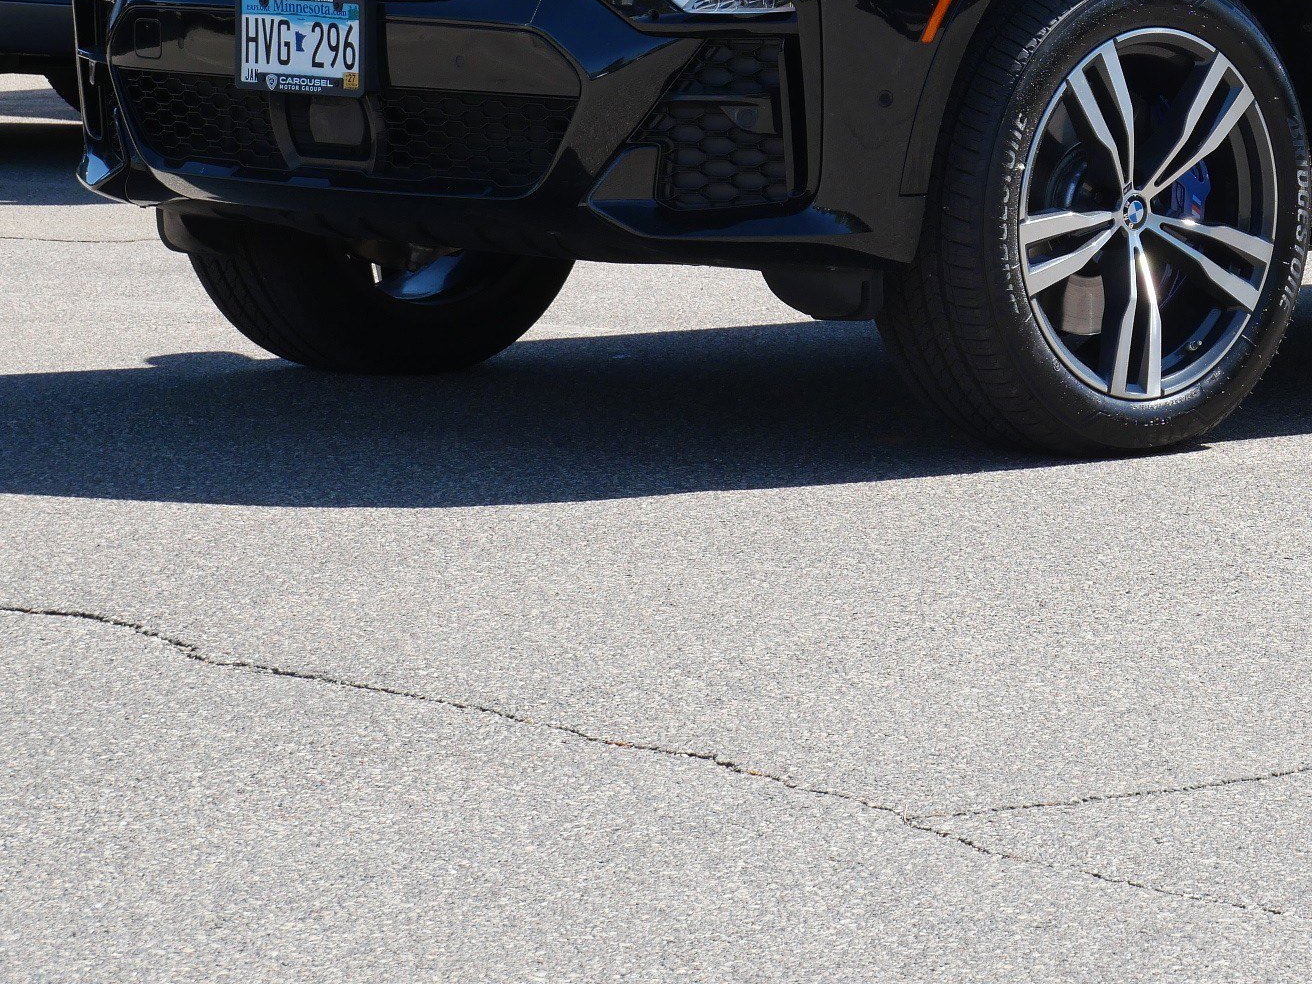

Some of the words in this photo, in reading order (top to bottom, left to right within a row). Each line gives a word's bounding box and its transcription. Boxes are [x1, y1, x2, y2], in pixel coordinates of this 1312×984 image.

[245, 16, 291, 66] HVG
[311, 21, 356, 71] 296
[244, 68, 259, 82] JAN
[279, 76, 334, 87] CAROUSEL
[279, 84, 300, 92] MOTOR
[301, 85, 322, 93] GROUP
